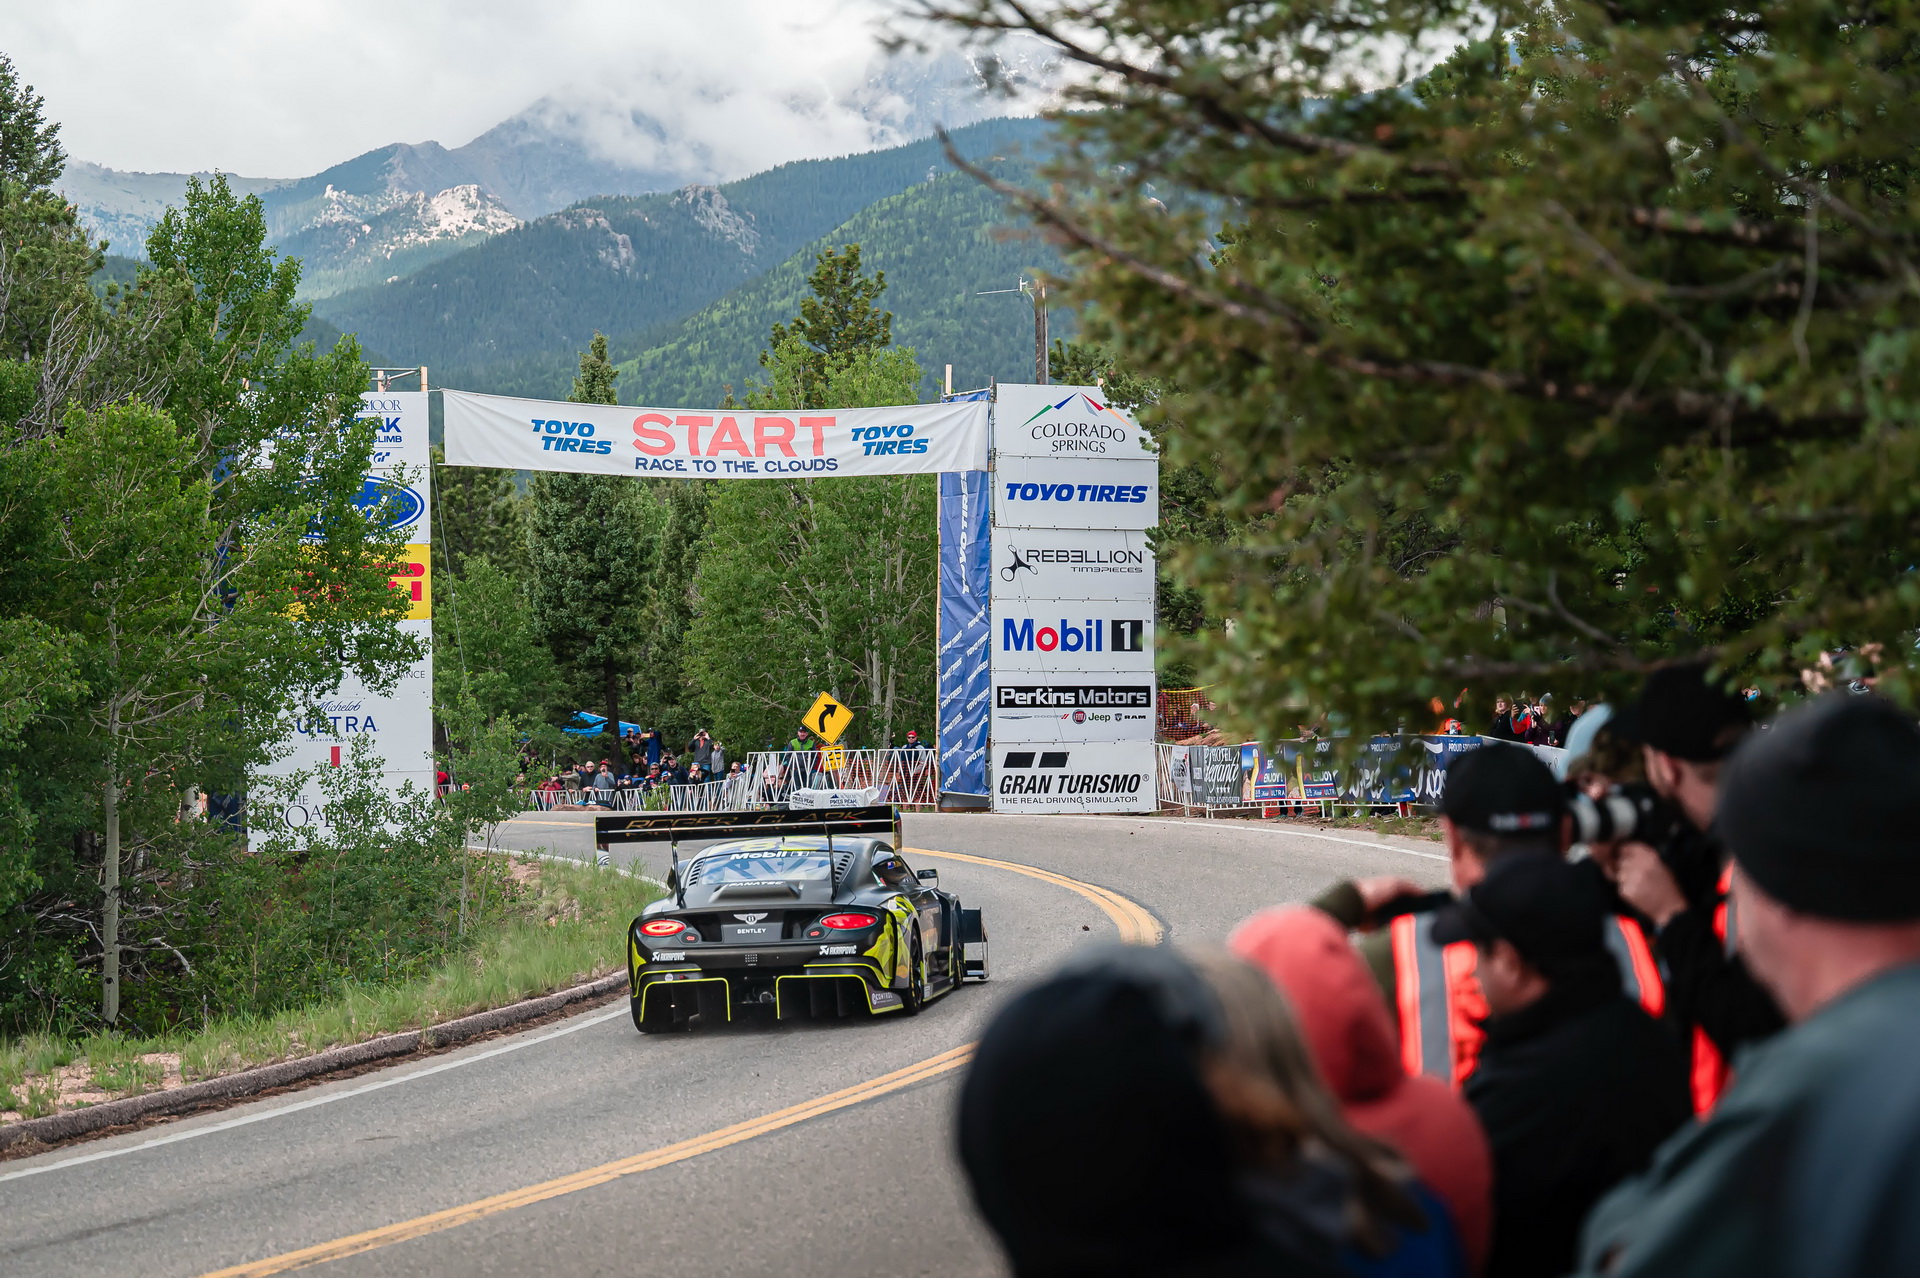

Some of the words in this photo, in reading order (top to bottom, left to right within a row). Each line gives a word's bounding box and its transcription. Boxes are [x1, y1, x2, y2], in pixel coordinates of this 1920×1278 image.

[531, 419, 595, 437] TOYO
[632, 413, 836, 457] START
[851, 424, 914, 441] TOYO
[1031, 423, 1126, 443] COLORADO
[541, 436, 612, 455] TIRES
[862, 438, 929, 456] TIRES
[1051, 439, 1106, 453] SPRINGS
[635, 457, 687, 472] RACE
[692, 459, 717, 473] TO
[723, 460, 758, 473] THE
[764, 458, 838, 473] CLOUDS
[1006, 483, 1075, 501] TOYO
[1077, 484, 1149, 503] TIRES
[1026, 549, 1143, 564] REBELLION
[1003, 618, 1103, 652] Mobil
[1000, 688, 1075, 705] Perkins
[1078, 689, 1147, 704] Motors
[313, 700, 362, 712] Michelob
[296, 715, 378, 734] ULTRA
[1088, 712, 1111, 722] Jeep
[1000, 775, 1052, 795] GRAN
[730, 851, 787, 860] Mobil
